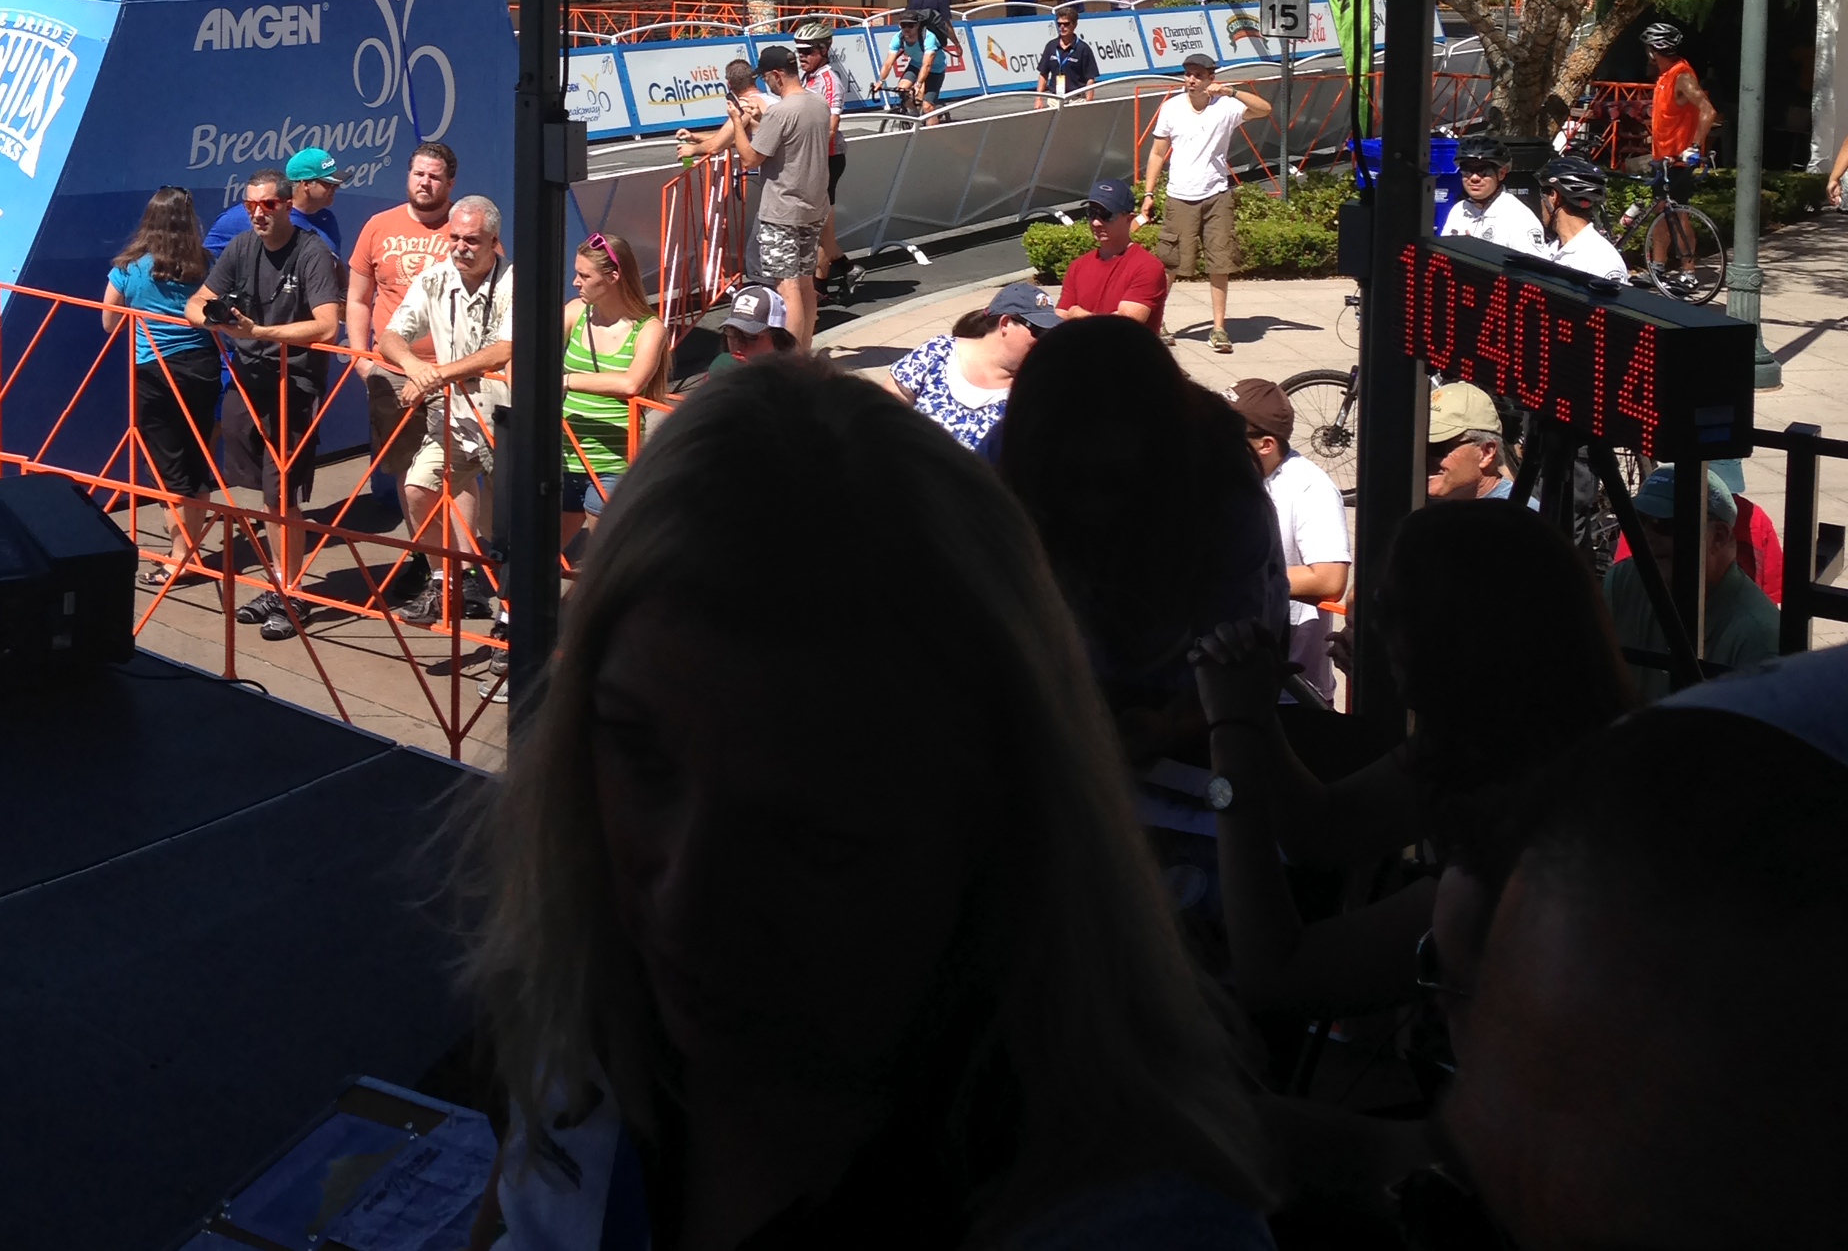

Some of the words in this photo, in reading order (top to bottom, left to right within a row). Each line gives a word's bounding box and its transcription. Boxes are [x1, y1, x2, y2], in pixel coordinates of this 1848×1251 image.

[13, 16, 63, 40] DRIED
[193, 3, 322, 52] AMGEN
[1268, 4, 1298, 31] 15
[1164, 26, 1203, 40] Champion
[1097, 38, 1135, 61] belkin
[1172, 40, 1203, 52] System
[691, 66, 720, 82] visit
[649, 76, 728, 116] Californ
[186, 115, 399, 170] Breakaway
[1399, 244, 1659, 457] 10:40:14
